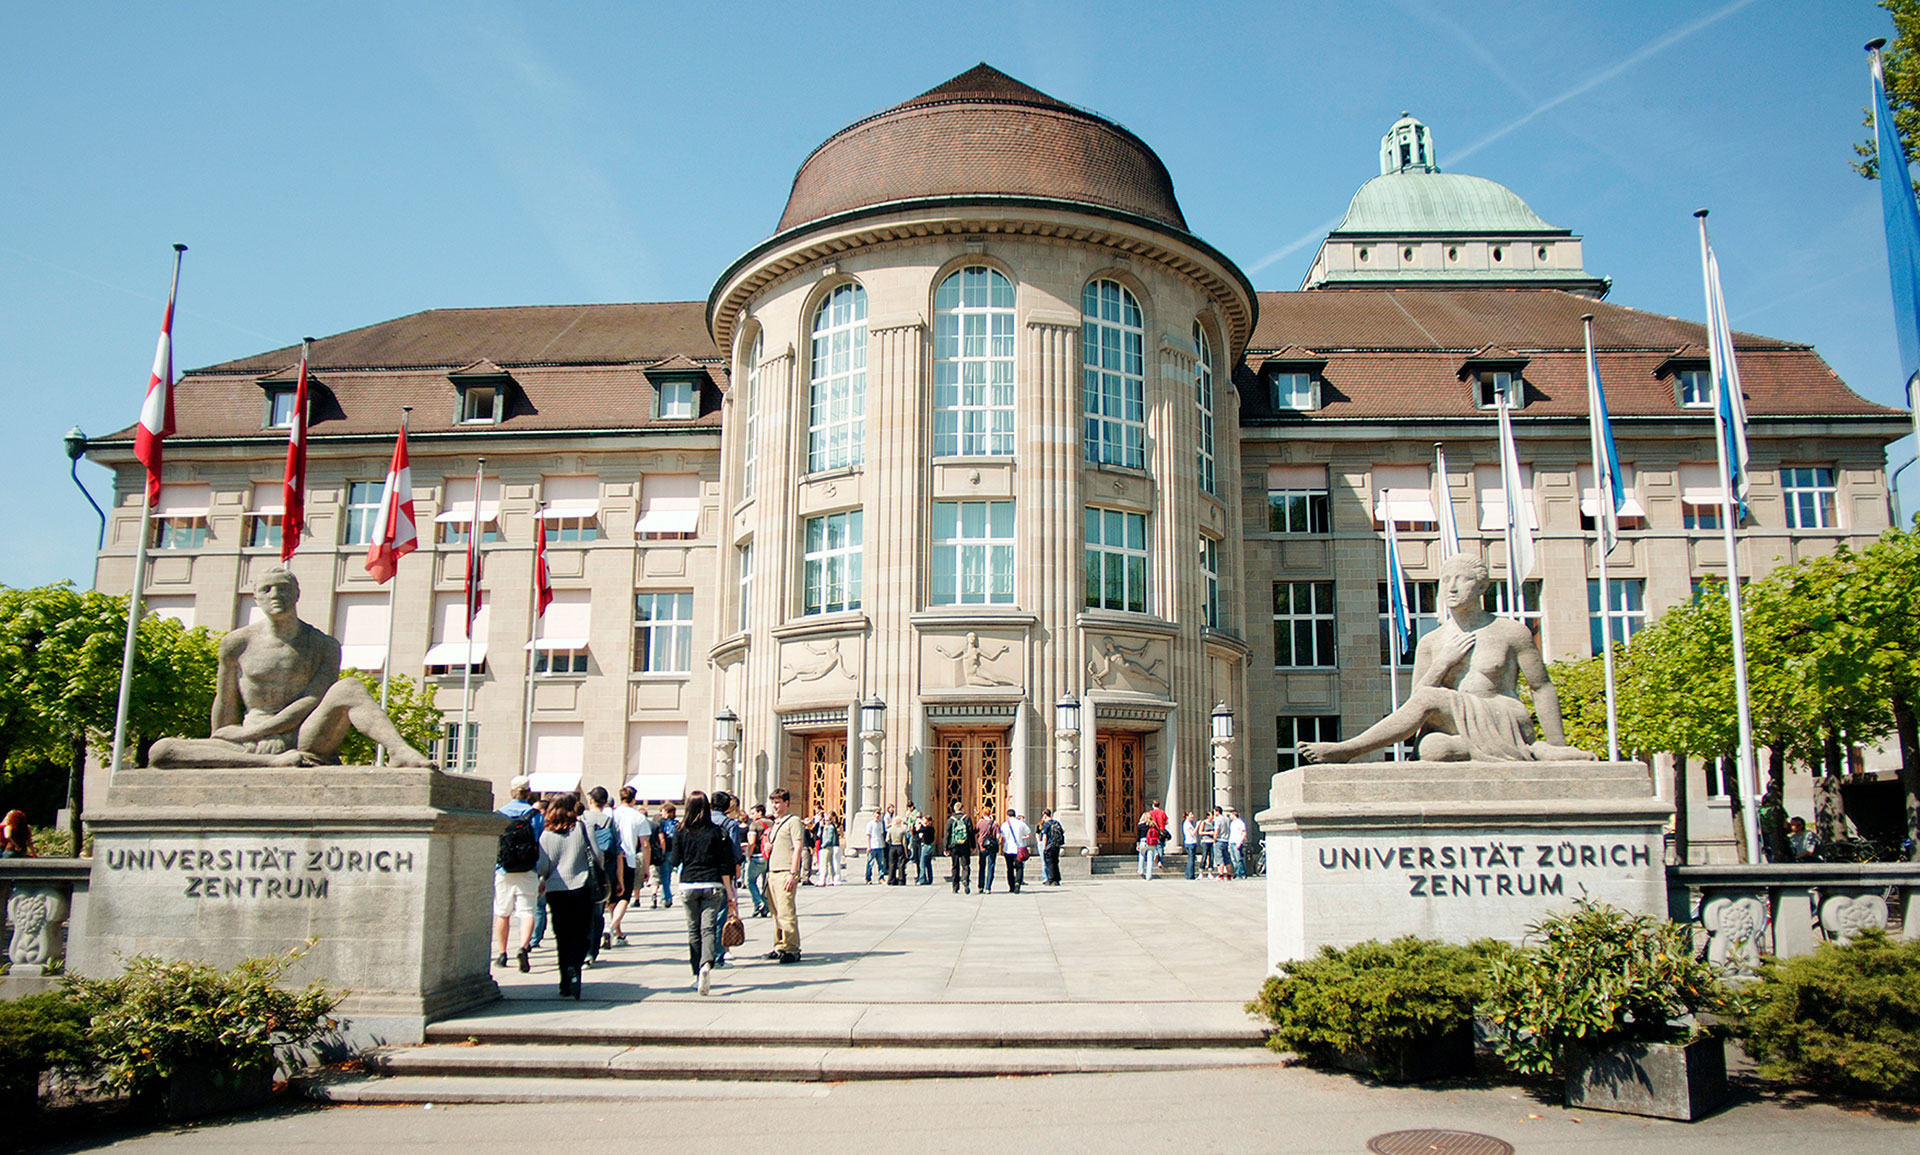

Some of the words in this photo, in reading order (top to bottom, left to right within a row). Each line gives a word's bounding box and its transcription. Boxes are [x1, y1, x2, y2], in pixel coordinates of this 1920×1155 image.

[107, 846, 296, 871] UNIVERSITÄT
[306, 846, 413, 872] ZÜRICH
[1318, 841, 1524, 869] UNIVERSITÄT
[1536, 841, 1651, 867] ZÜRICH
[184, 876, 329, 899] ZENTRUM
[1409, 873, 1564, 897] ZENTRUM
